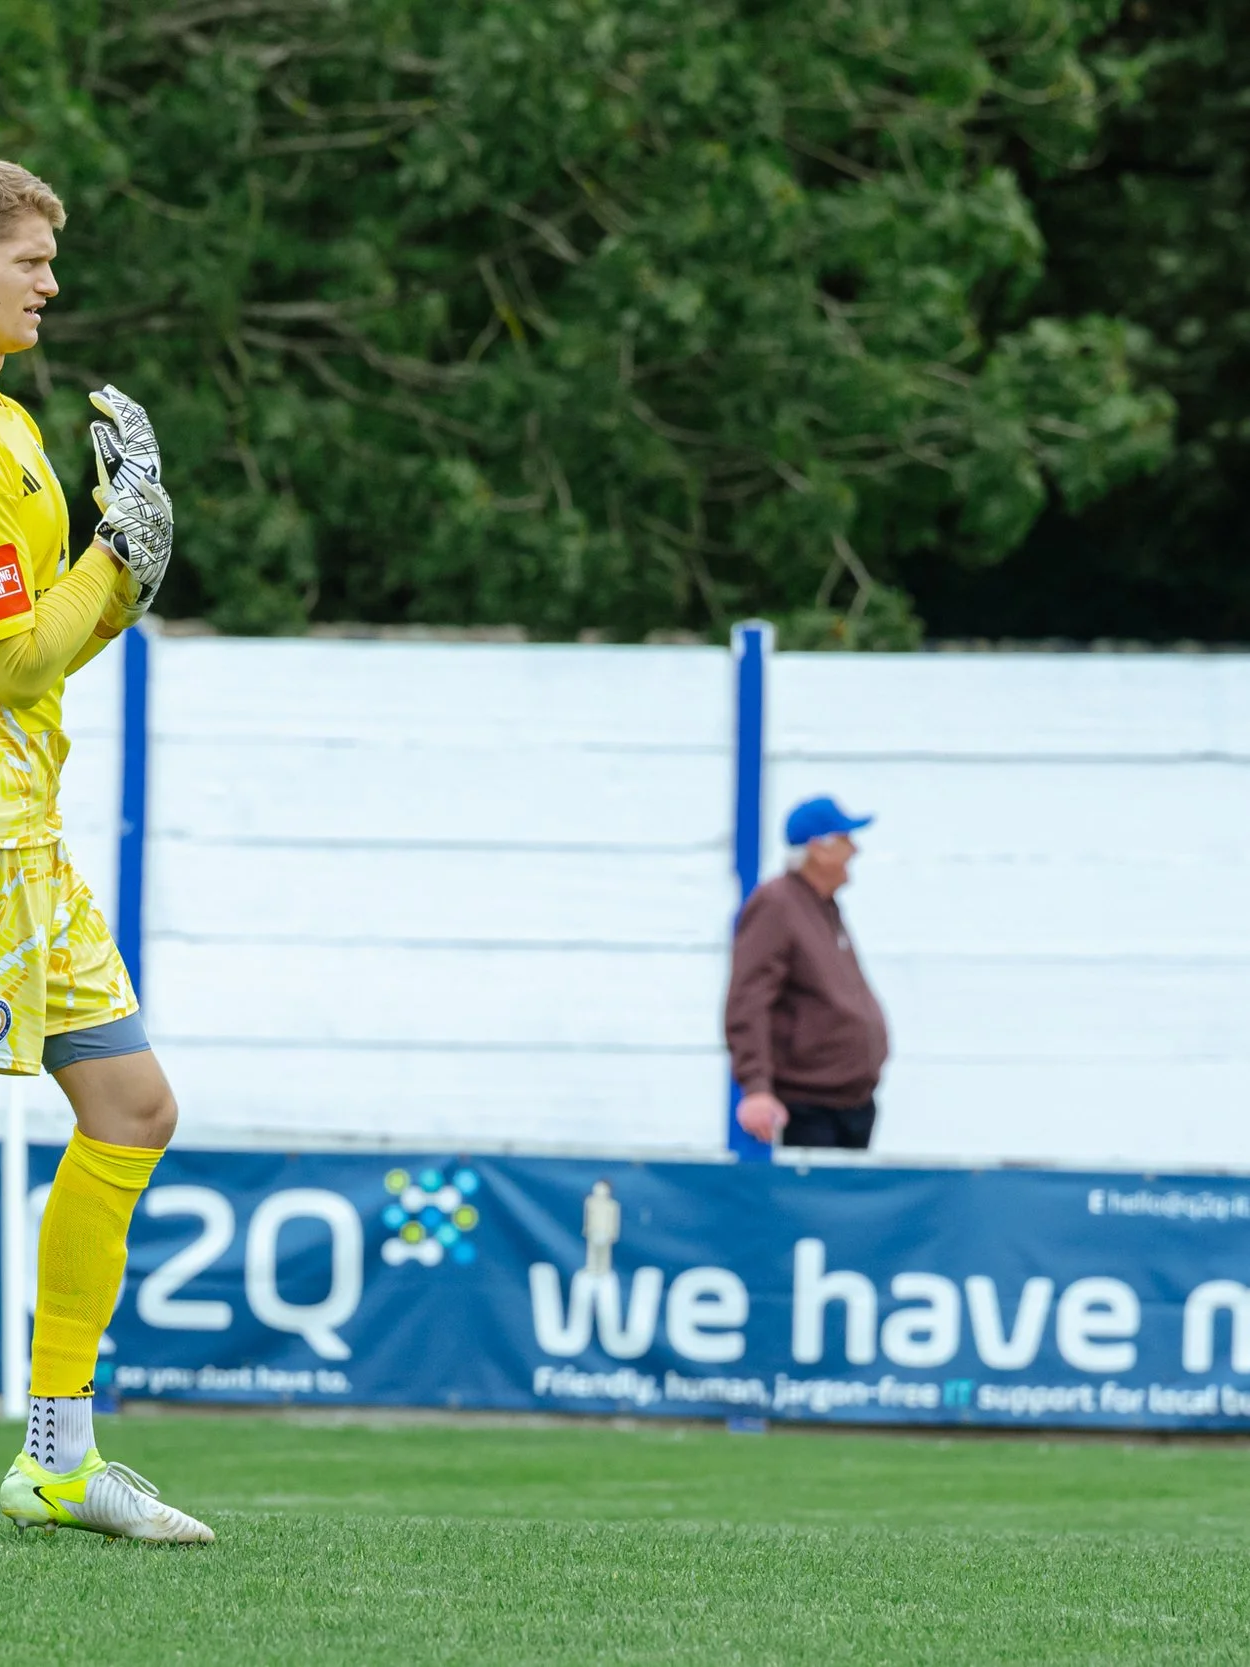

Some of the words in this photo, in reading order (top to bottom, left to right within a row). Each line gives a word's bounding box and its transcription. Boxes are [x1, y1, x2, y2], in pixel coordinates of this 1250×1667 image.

[28, 1181, 365, 1361] 2Q
[528, 1261, 751, 1363] we
[792, 1237, 1141, 1373] have
[254, 1364, 314, 1393] have
[943, 1378, 973, 1408] IT
[976, 1383, 1098, 1417] support
[1100, 1380, 1146, 1414] for
[1148, 1383, 1219, 1416] local
